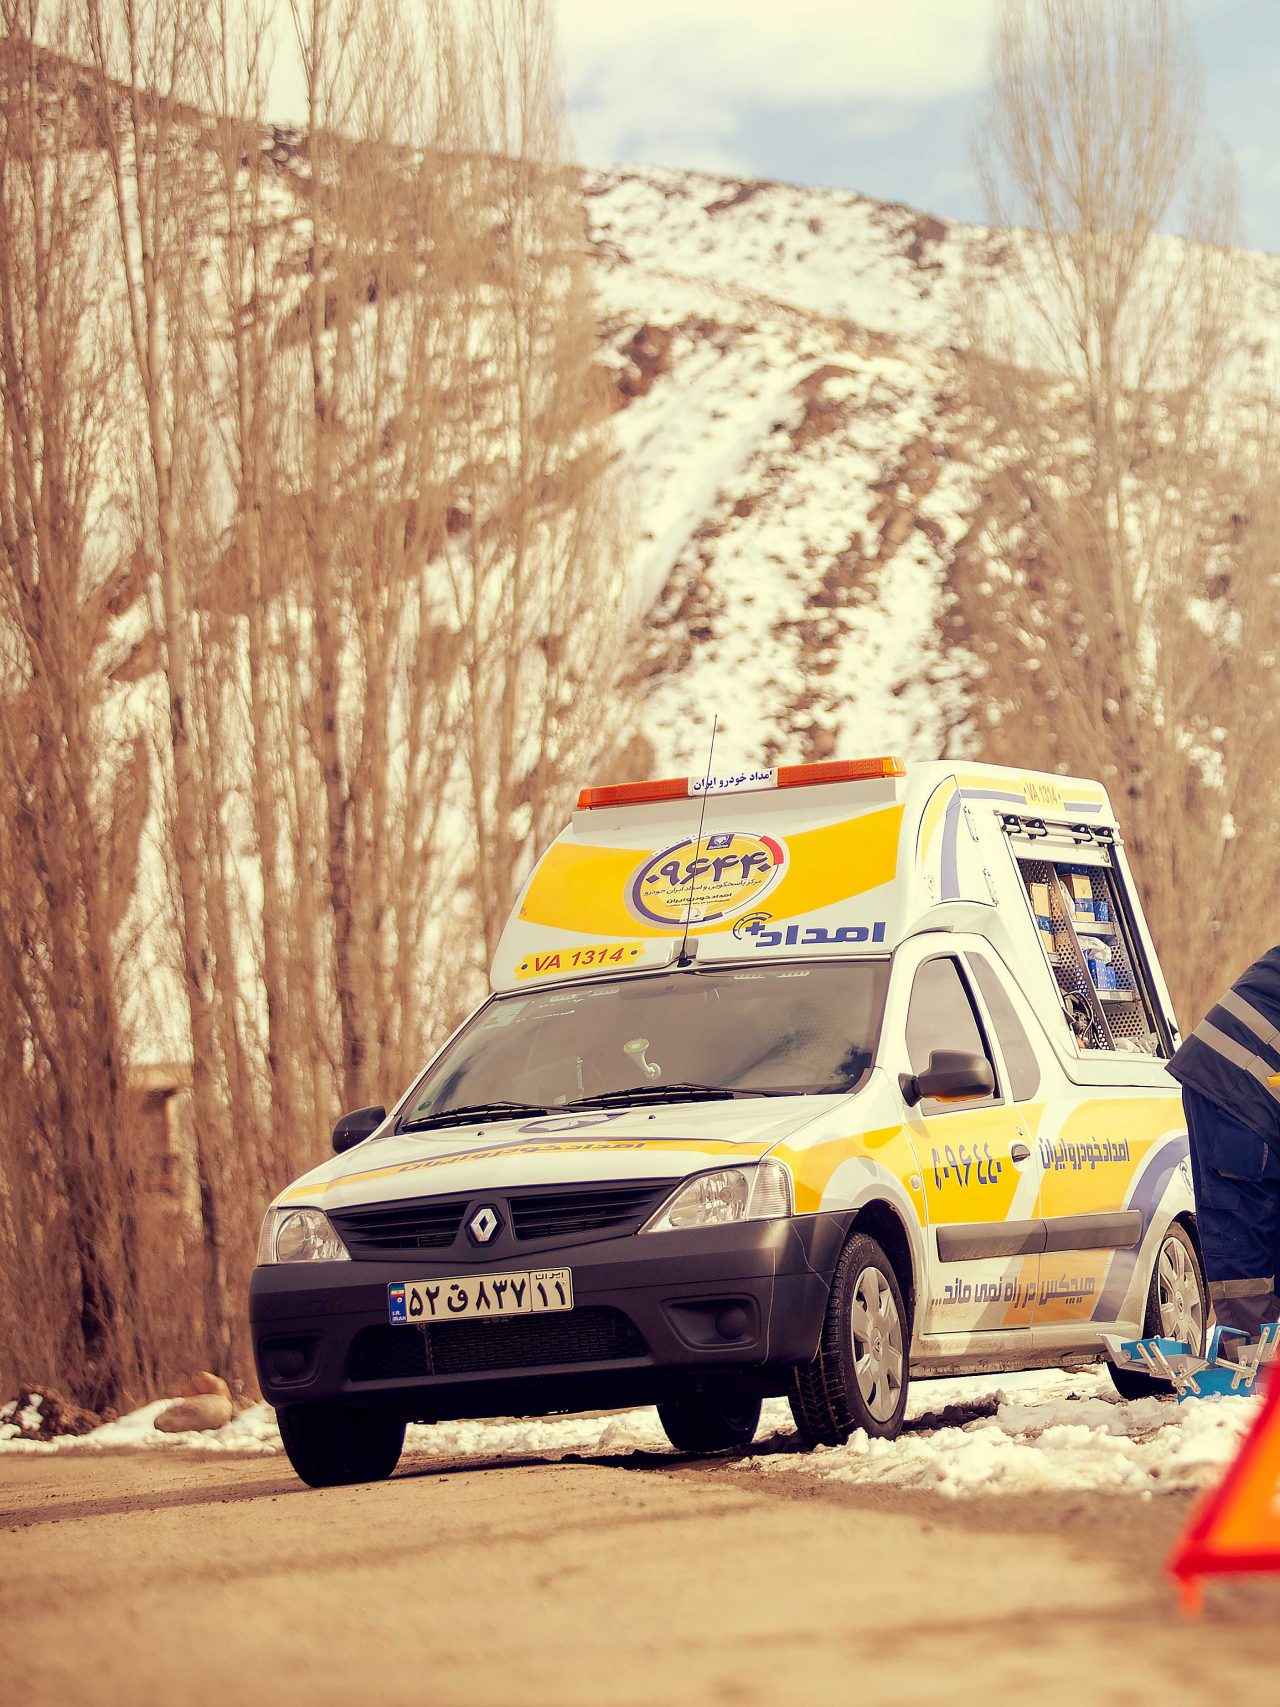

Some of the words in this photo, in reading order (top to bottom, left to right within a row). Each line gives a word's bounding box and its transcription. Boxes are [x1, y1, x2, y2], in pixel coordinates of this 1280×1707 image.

[693, 777, 716, 790] ایران
[719, 773, 746, 788] خودرو
[755, 921, 887, 948] امداد
[535, 954, 561, 972] VA
[571, 947, 625, 967] 1314
